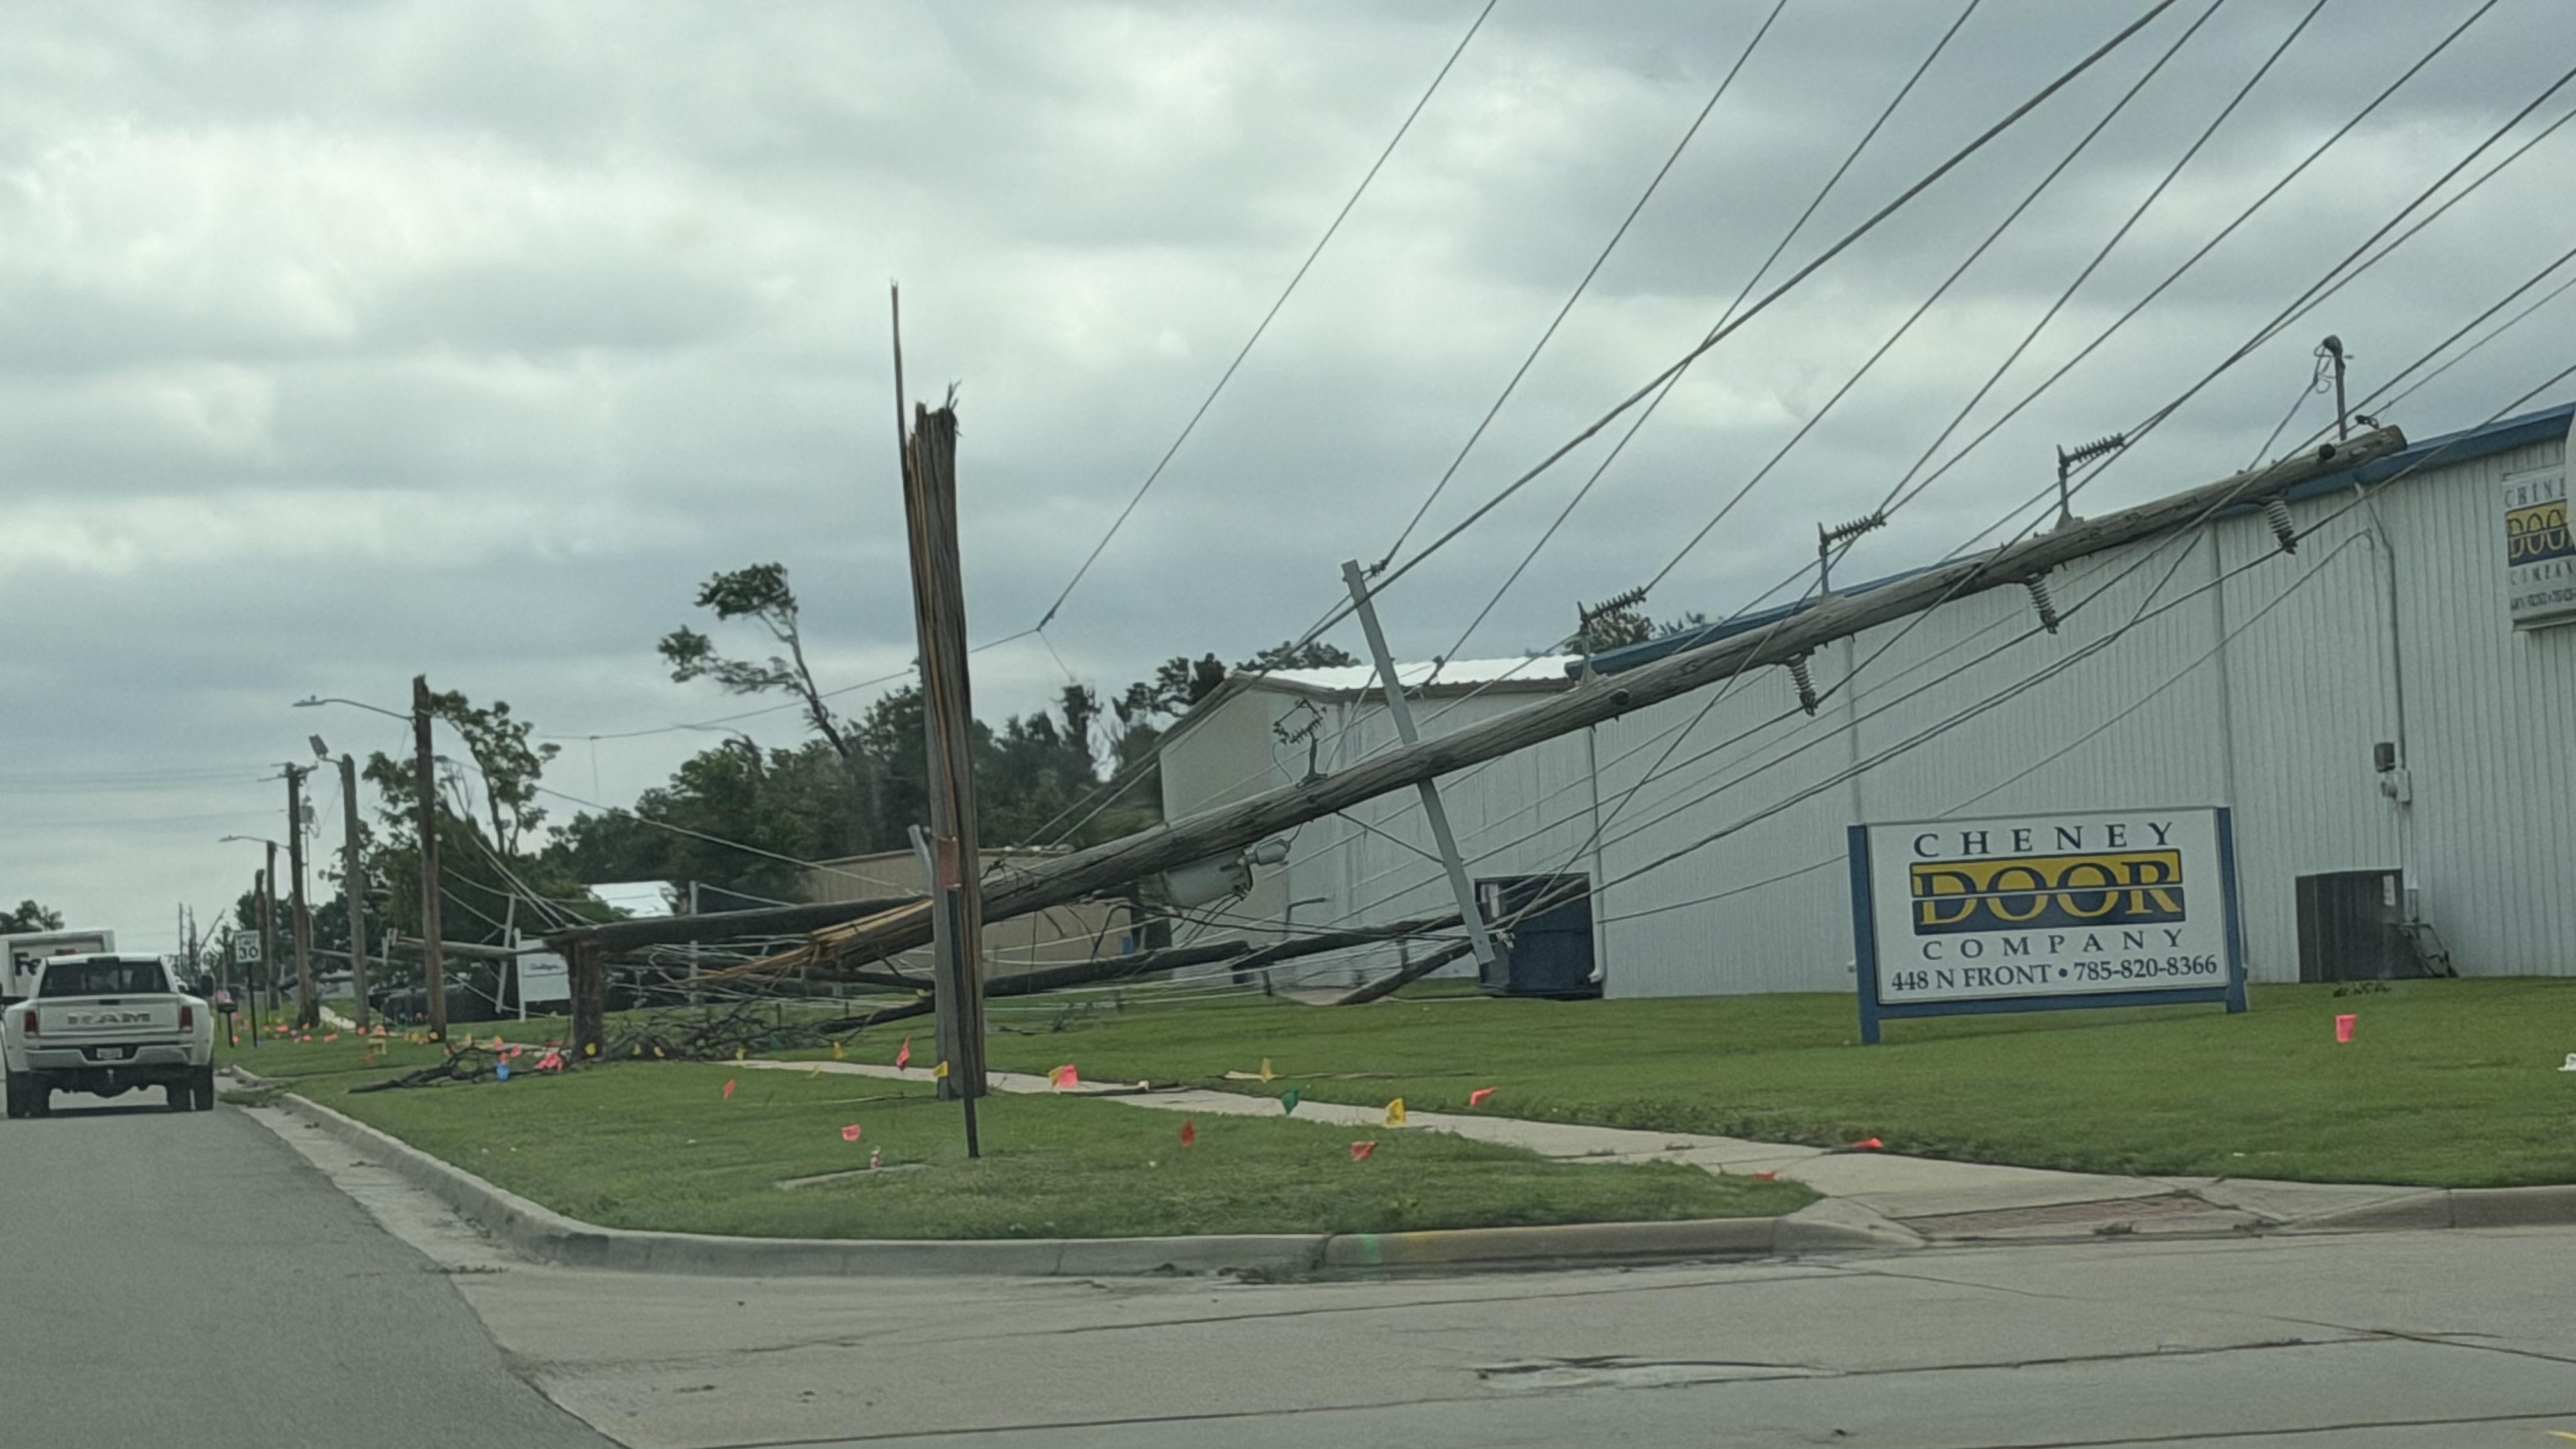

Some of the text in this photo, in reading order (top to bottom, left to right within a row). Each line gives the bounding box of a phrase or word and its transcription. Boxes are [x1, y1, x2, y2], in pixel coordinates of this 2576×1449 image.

[1913, 822, 2172, 858] CHENEY
[1913, 860, 2182, 925] DOOR
[1922, 928, 2182, 960] COMPANY
[1891, 954, 2218, 991] 448 N FRONT 785-820-8366
[67, 1012, 151, 1025] RAM
